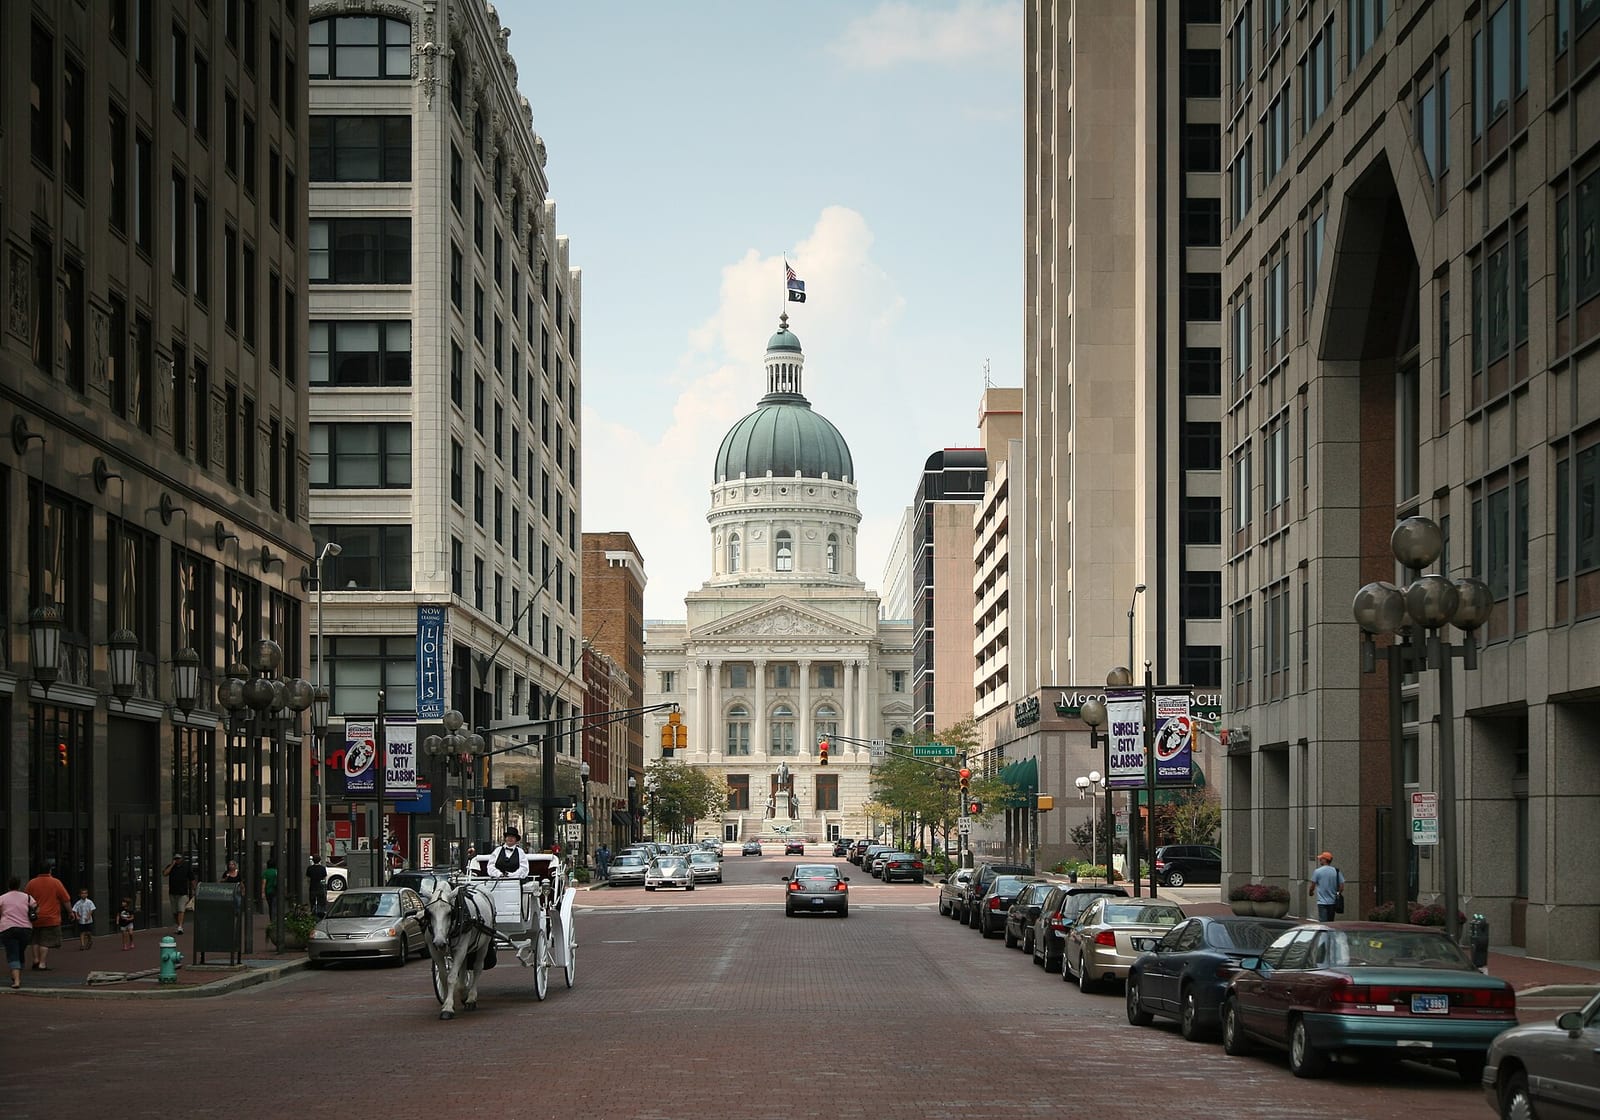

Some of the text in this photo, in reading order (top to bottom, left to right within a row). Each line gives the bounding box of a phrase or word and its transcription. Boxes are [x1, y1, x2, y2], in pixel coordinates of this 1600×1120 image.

[423, 628, 435, 698] LOFTS
[421, 704, 440, 712] CALL
[1112, 721, 1139, 736] CIRCLE
[388, 743, 413, 755] CIRCLE
[1118, 738, 1135, 752] CITY
[393, 756, 409, 769] CITY
[1110, 753, 1143, 768] CLASSIC
[386, 770, 415, 782] CLASSIC
[1414, 821, 1420, 831] 2
